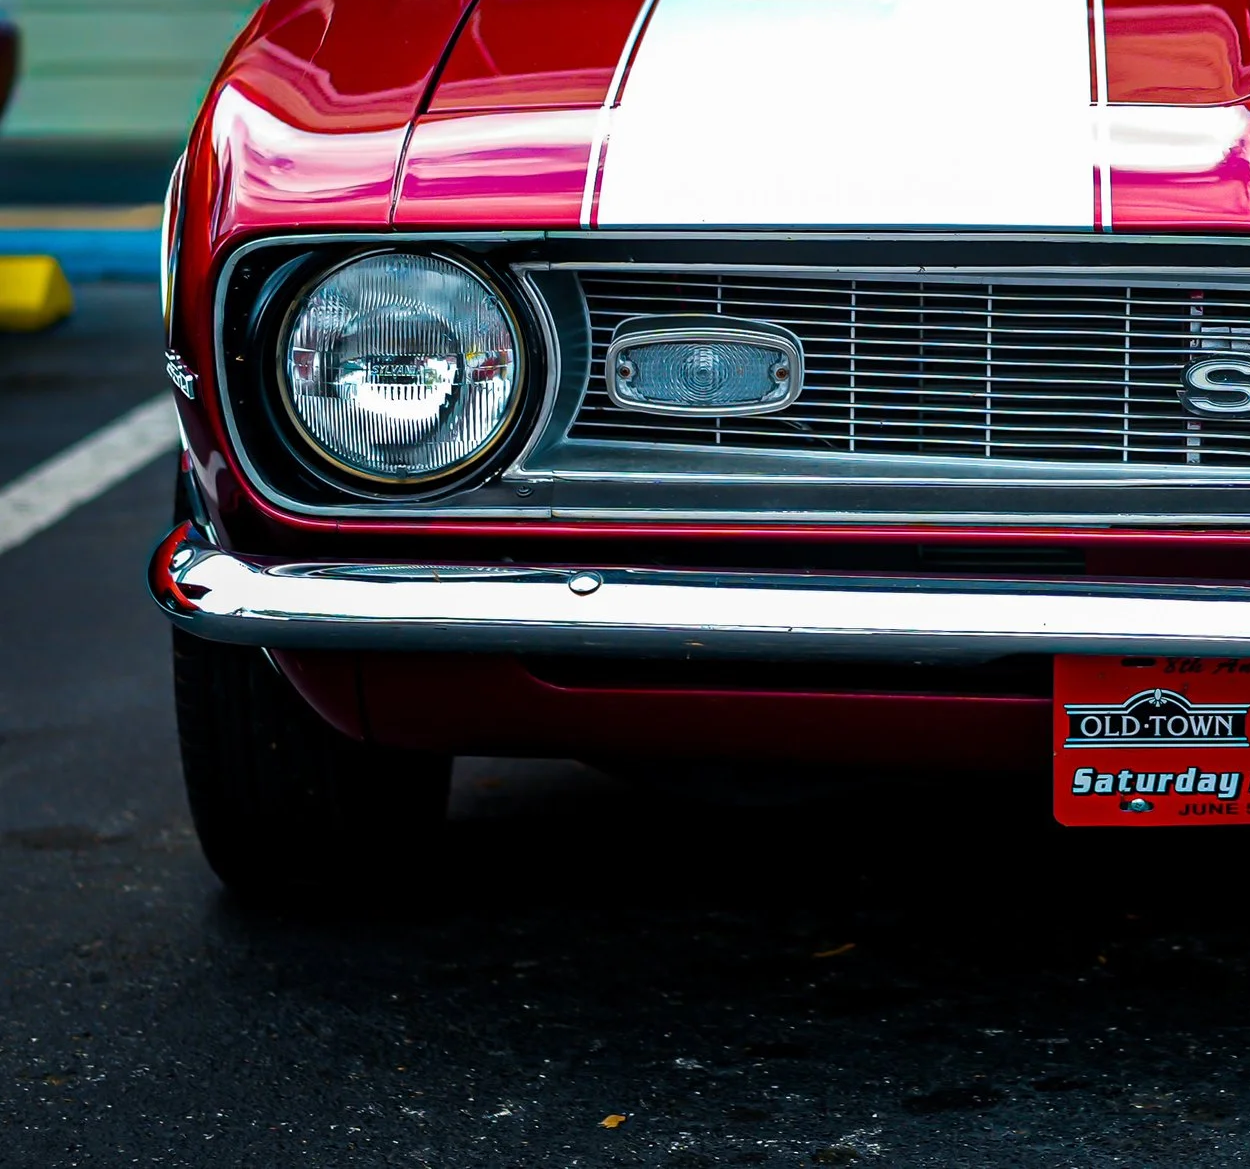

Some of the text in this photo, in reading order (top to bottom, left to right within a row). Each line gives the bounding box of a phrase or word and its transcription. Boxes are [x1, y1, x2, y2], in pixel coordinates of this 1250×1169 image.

[1080, 714, 1235, 737] OLD TOWN
[1072, 767, 1240, 799] Saturday
[1178, 802, 1240, 816] JUNE
